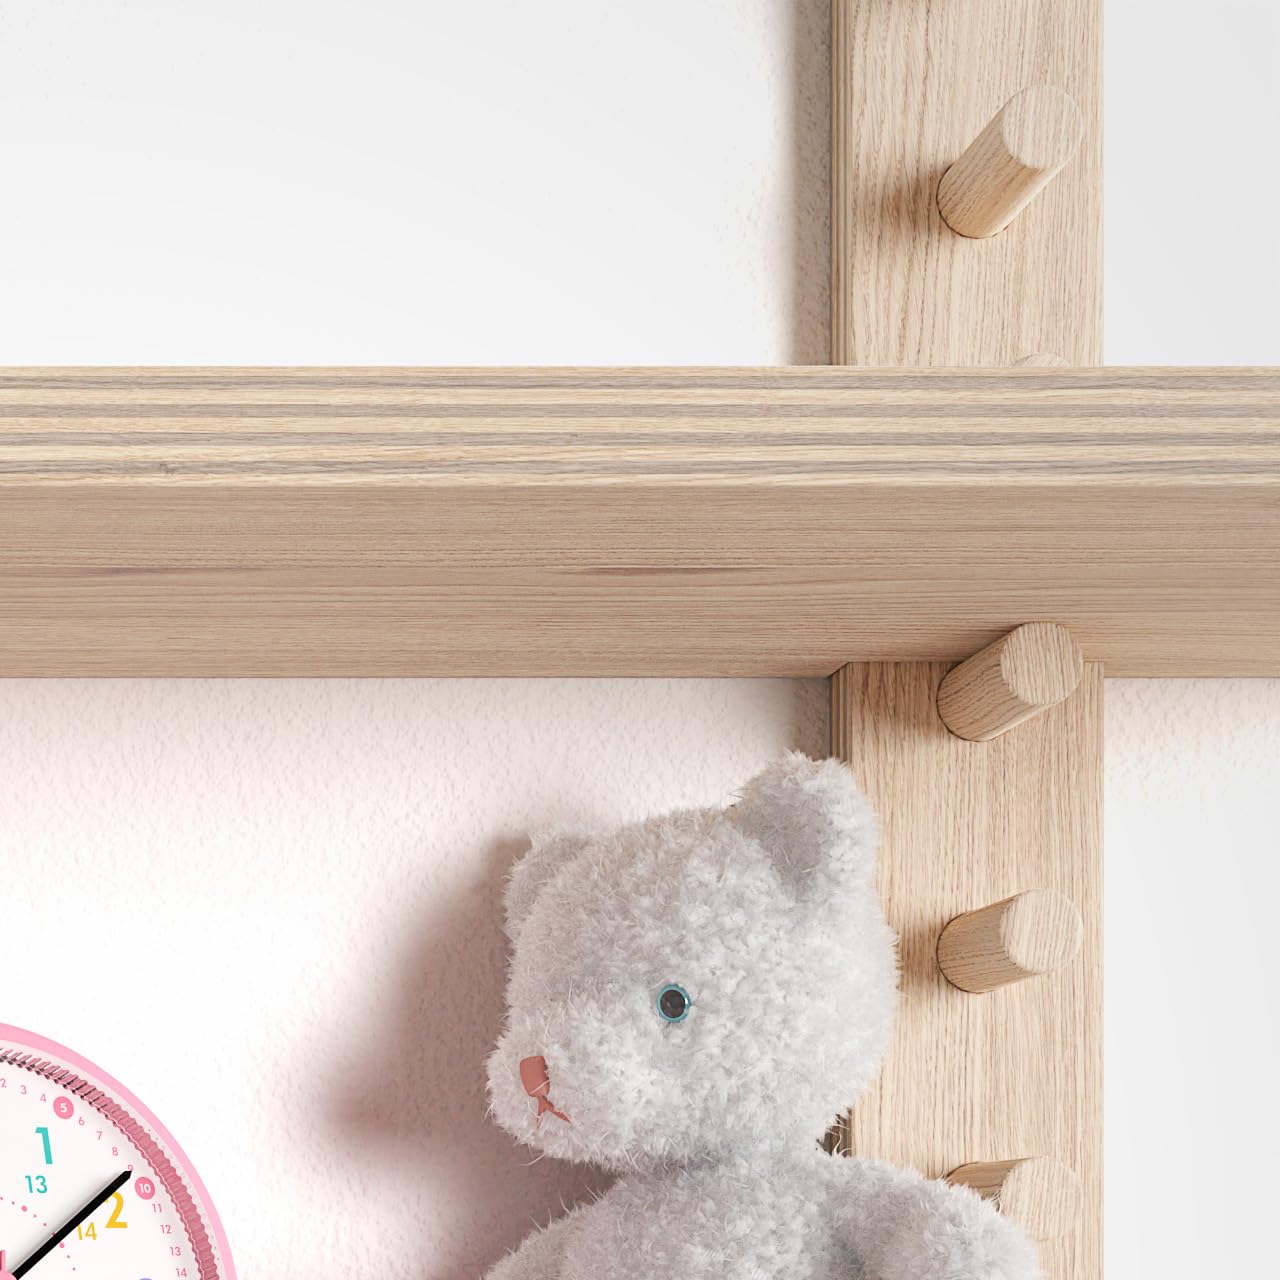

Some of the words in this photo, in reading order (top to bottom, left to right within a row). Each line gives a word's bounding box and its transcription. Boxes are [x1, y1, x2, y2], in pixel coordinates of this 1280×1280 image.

[0, 1078, 7, 1088] 2
[20, 1085, 27, 1095] 3
[40, 1093, 47, 1103] 4
[60, 1103, 67, 1112] 5
[78, 1117, 85, 1126] 6
[96, 1131, 103, 1140] 7
[35, 1127, 53, 1165] 1
[112, 1147, 119, 1156] 8
[25, 1175, 48, 1193] 13
[139, 1184, 151, 1194] 10
[105, 1191, 128, 1229] 2
[152, 1204, 162, 1213] 11
[77, 1222, 97, 1241] 14
[160, 1225, 172, 1234] 12
[170, 1247, 182, 1256] 13
[176, 1268, 187, 1278] 14
